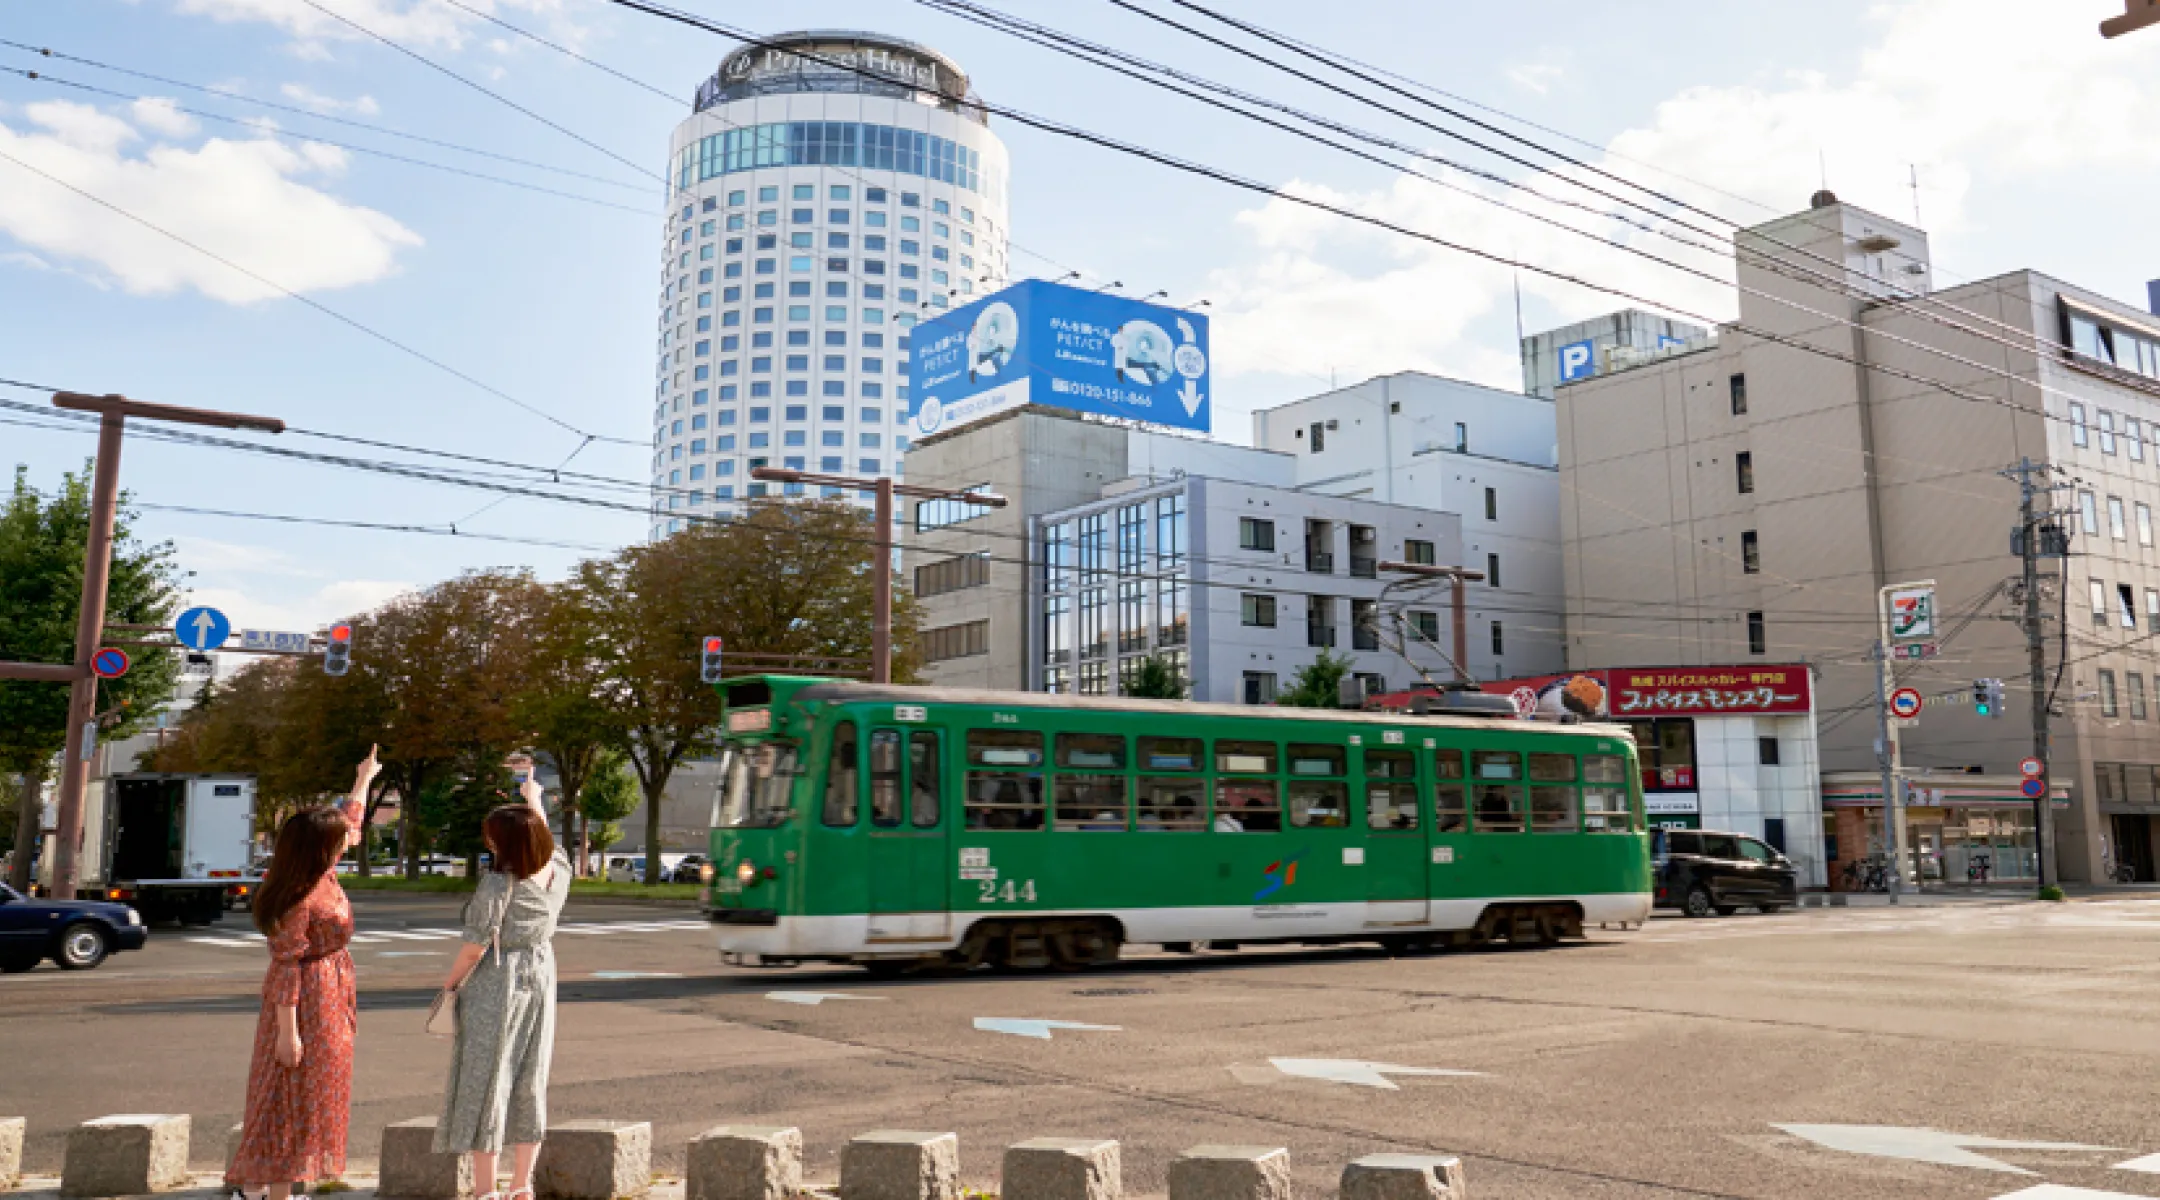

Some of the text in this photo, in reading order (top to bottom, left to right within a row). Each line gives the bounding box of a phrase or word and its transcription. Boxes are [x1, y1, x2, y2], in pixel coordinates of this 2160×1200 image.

[866, 49, 936, 88] Hotel
[1056, 331, 1103, 351] PET/CT
[1563, 345, 1588, 379] P
[1619, 685, 1800, 712] スパイスモンスター
[977, 878, 1038, 904] 244
